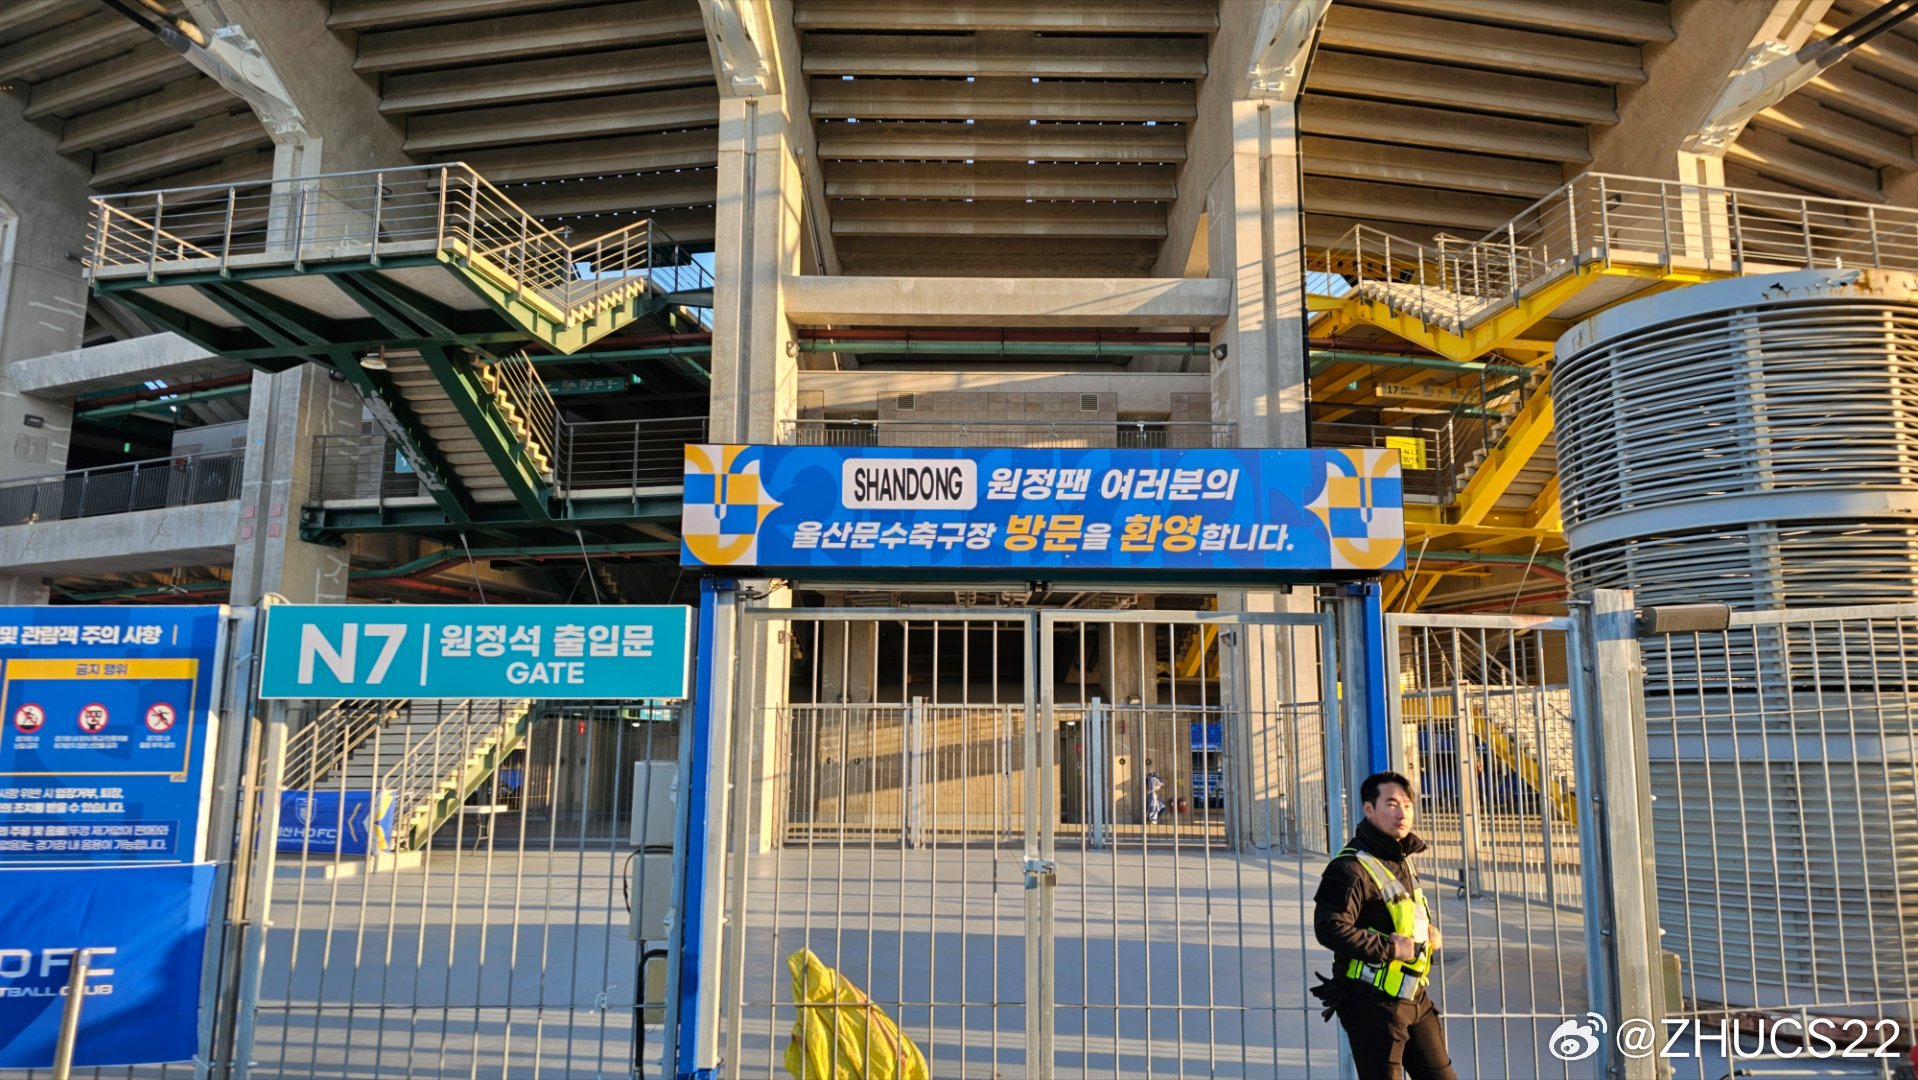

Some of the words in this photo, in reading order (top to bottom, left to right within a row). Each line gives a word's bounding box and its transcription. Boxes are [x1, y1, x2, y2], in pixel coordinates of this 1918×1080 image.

[1387, 385, 1399, 394] 17
[854, 466, 963, 501] SHANDONG
[987, 468, 1092, 500] 원정팬
[1100, 468, 1239, 501] 여러분의
[792, 520, 997, 550] 울산문수축구장
[1003, 514, 1111, 552] 방문을
[1120, 514, 1294, 552] 환영합니다.
[21, 626, 79, 645] 관람객
[81, 626, 120, 645] 주의
[122, 625, 163, 645] 사항
[439, 624, 541, 658] 원정석
[552, 624, 655, 658] 출입문
[297, 623, 407, 685] N7
[76, 663, 100, 676] 금지
[104, 663, 128, 676] 행위
[506, 661, 585, 685] GATE
[59, 984, 114, 997] CUB
